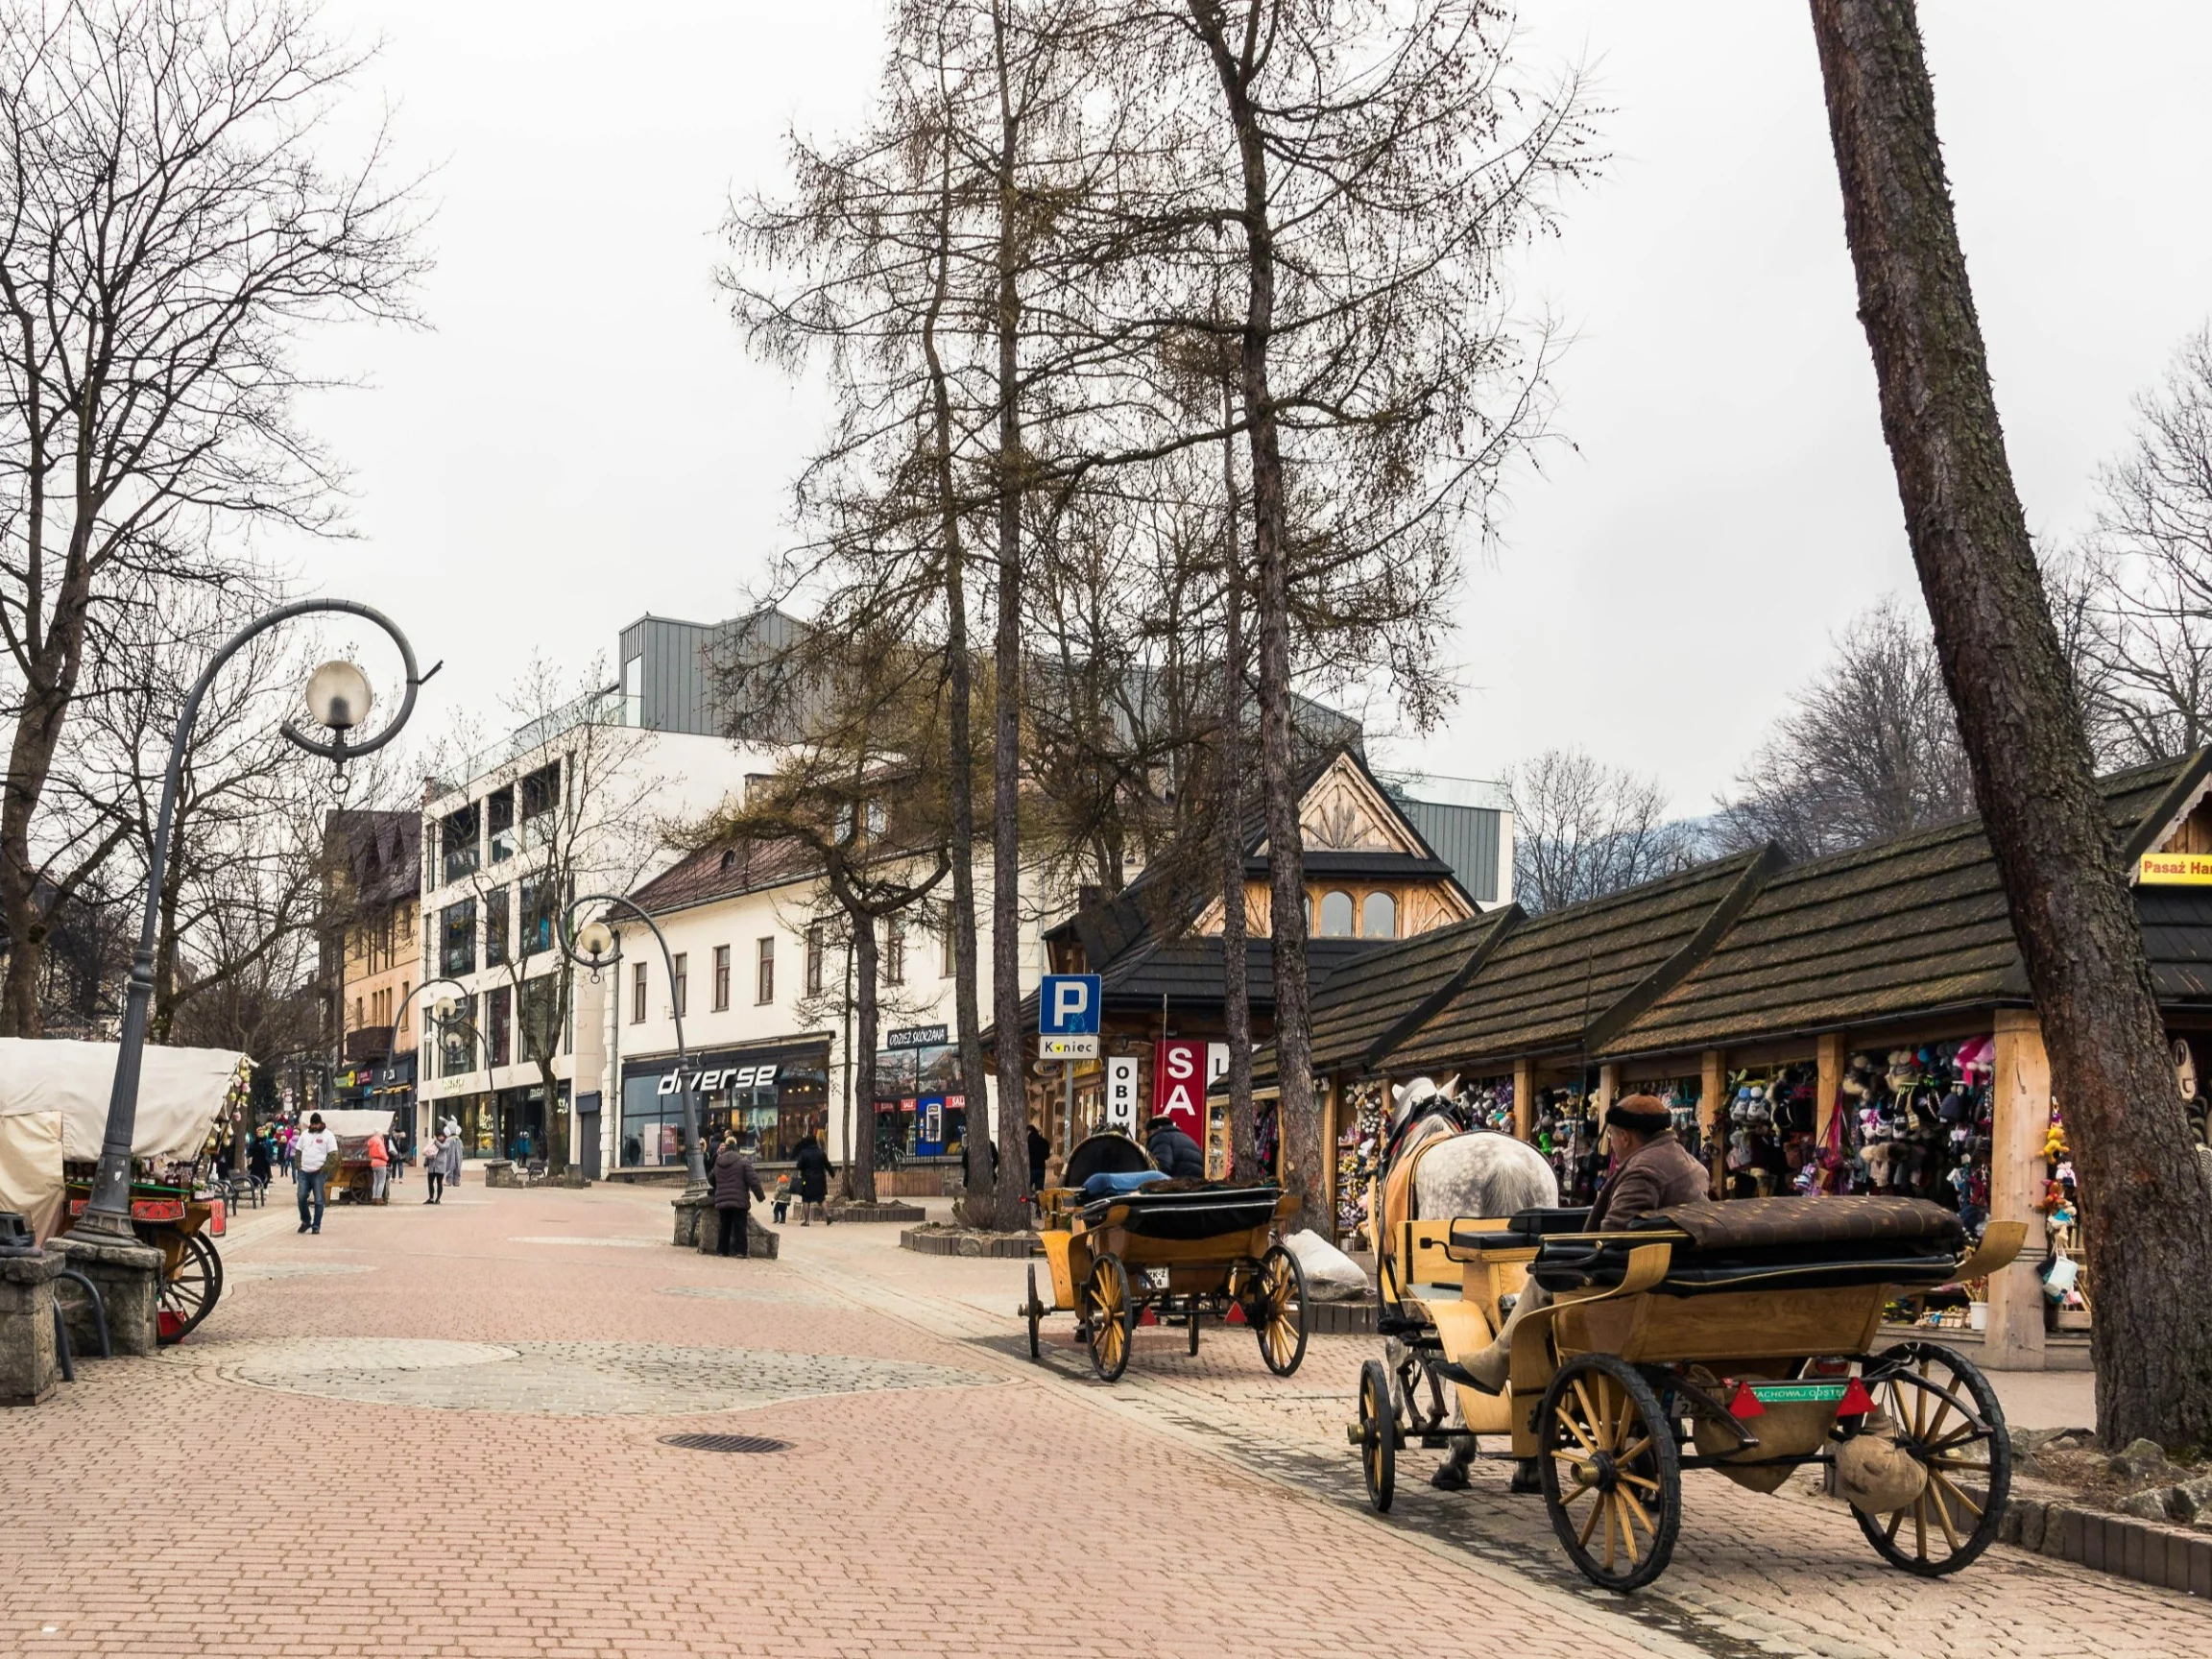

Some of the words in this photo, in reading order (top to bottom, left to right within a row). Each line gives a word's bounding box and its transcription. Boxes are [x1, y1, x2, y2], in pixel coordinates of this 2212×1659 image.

[2144, 860, 2186, 874] Pasaż
[1053, 981, 1089, 1027] P
[1045, 1041, 1092, 1053] Kniec
[657, 1065, 778, 1095] diverse
[1163, 1046, 1196, 1126] SA
[1754, 1388, 1806, 1398] ACHOWAJ
